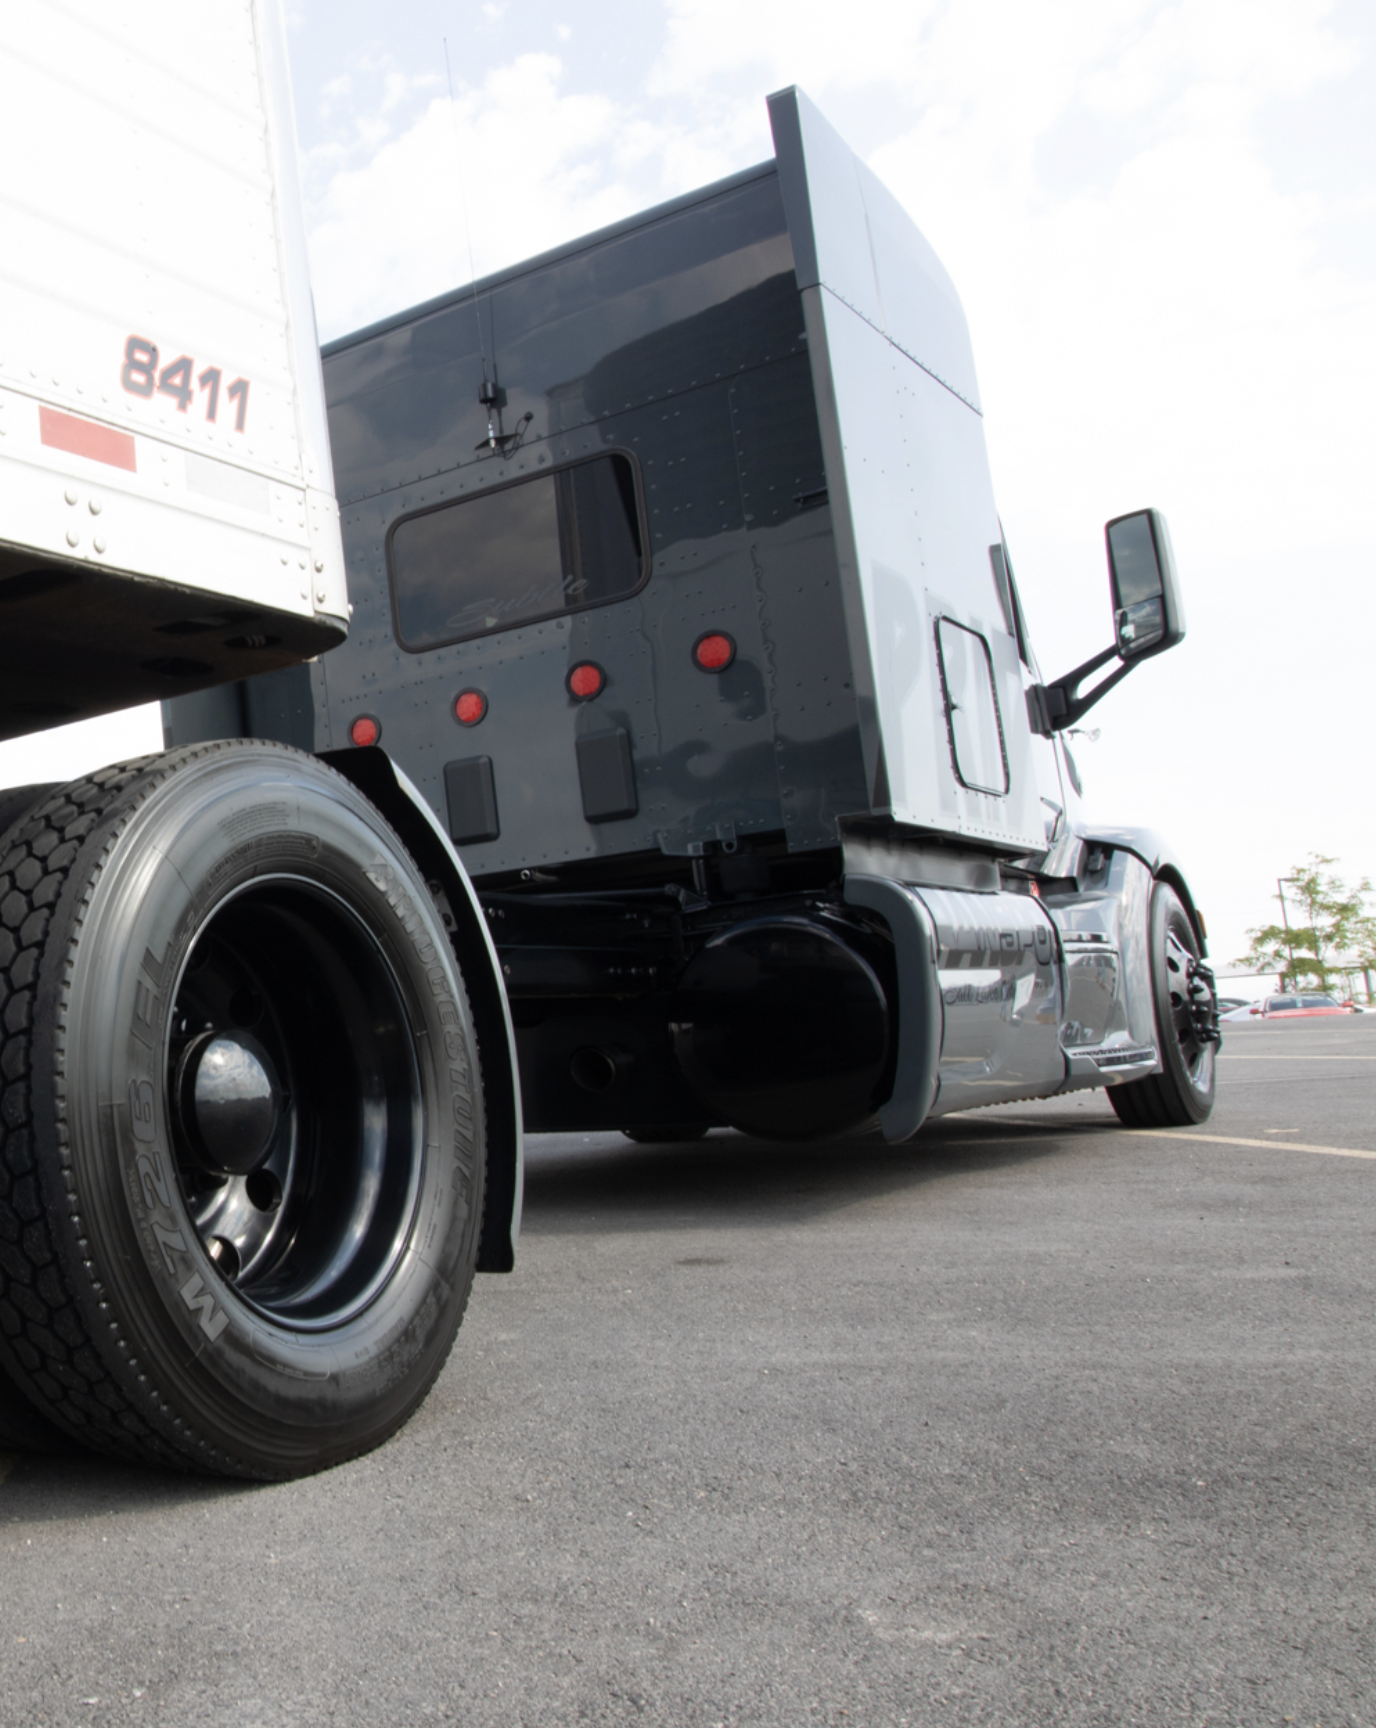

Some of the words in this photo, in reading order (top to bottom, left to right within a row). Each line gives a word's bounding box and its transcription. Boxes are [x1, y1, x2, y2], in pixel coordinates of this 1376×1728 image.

[121, 334, 250, 434] 8411
[130, 944, 172, 1050] EL
[364, 854, 472, 1199] BRIDGESTONE
[129, 1079, 231, 1344] M726
